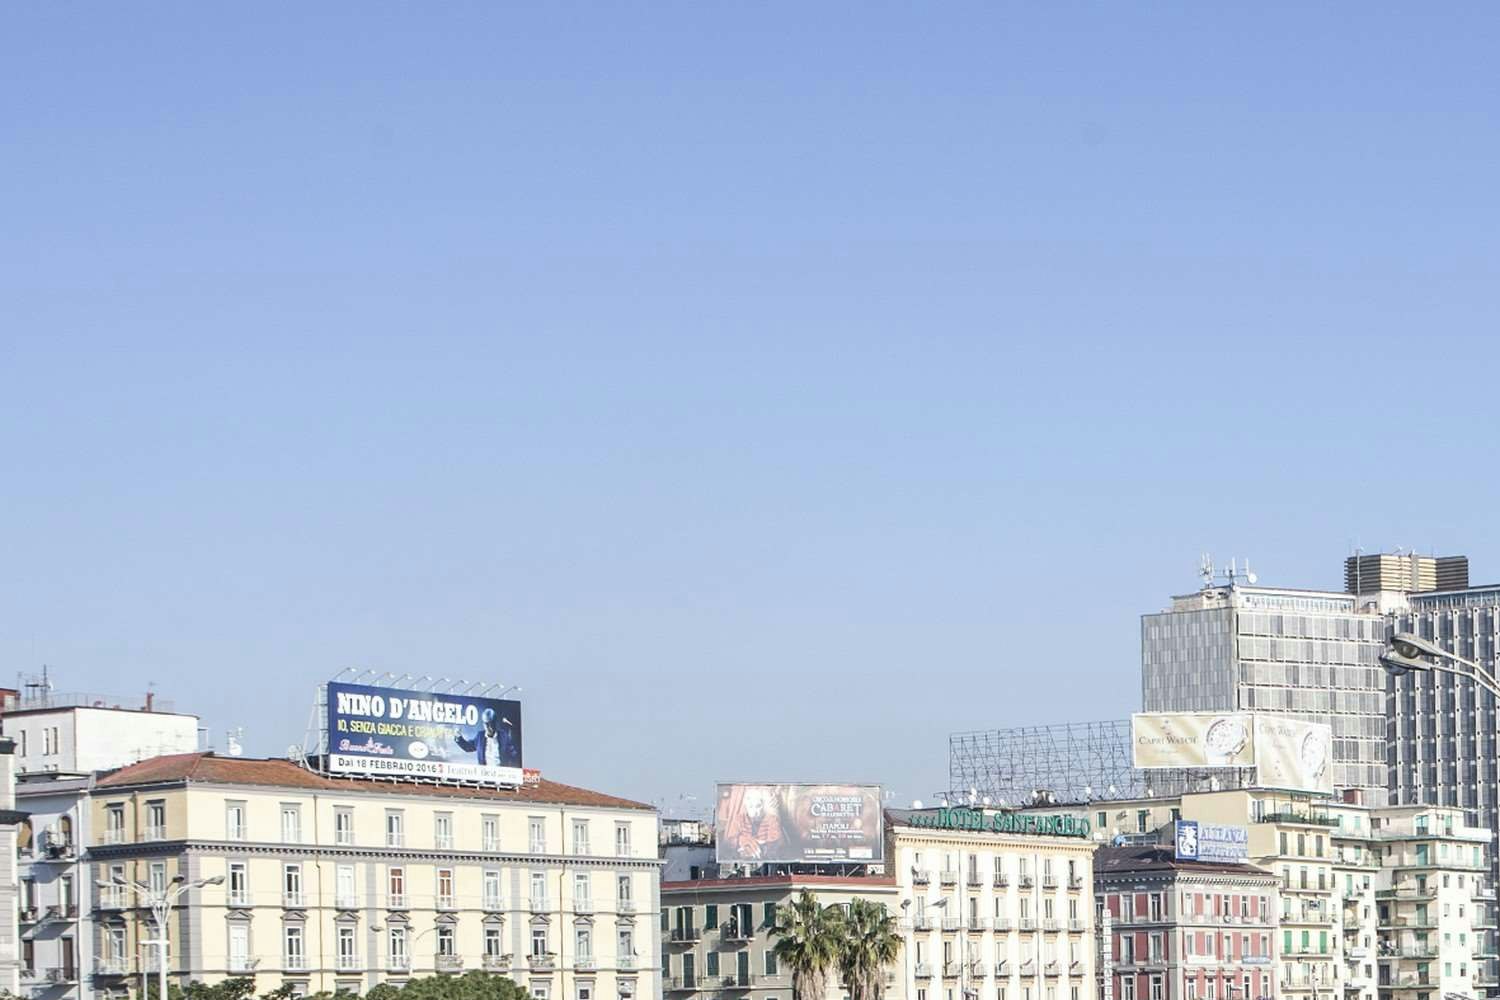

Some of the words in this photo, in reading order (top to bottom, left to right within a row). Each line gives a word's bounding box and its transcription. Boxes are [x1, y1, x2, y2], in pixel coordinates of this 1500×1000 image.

[337, 692, 385, 718] NINO
[389, 696, 478, 726] D'ANGELO
[349, 720, 377, 734] SENZA
[378, 723, 407, 737] GIACCA
[408, 725, 414, 737] E
[356, 760, 367, 768] 18
[369, 760, 413, 772] FEBBRAIO
[416, 763, 437, 774] 2016
[811, 802, 862, 816] CABARET
[938, 808, 992, 831] HOTEL
